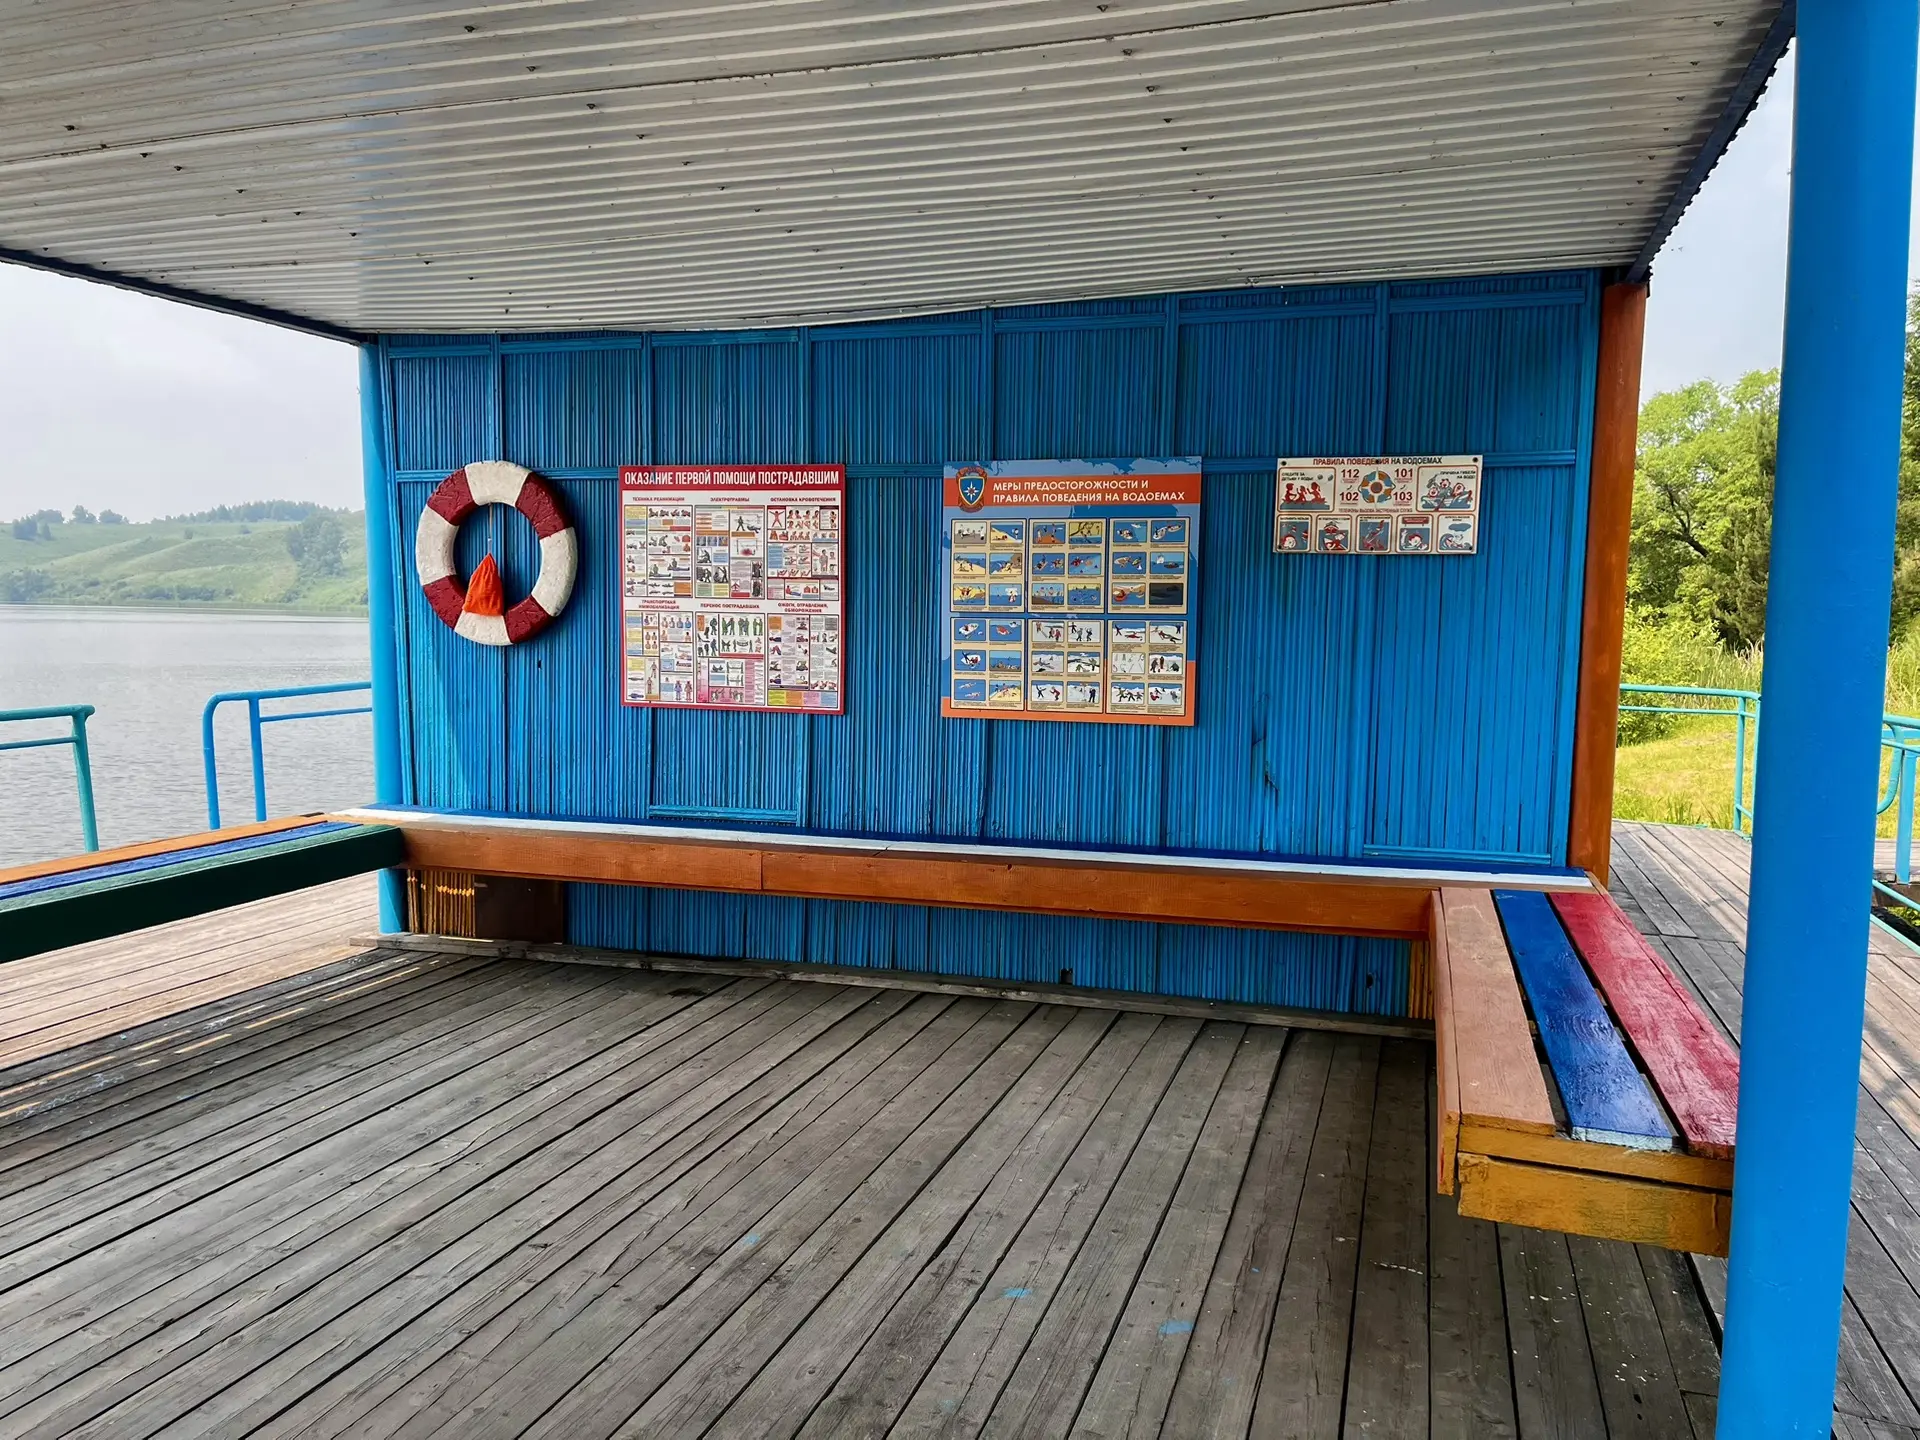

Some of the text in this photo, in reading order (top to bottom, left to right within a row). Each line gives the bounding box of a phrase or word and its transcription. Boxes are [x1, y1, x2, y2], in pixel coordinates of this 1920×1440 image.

[1402, 457, 1442, 465] ВОДОЕМАХ
[624, 469, 839, 486] ОКАЗАНИЕ ПЕРВОЙ ПОМОЩИ ПОСТРАДАВШИМ
[1341, 469, 1360, 478] 112
[1394, 468, 1413, 478] 101
[993, 480, 1149, 491] МЕРЫ ПРЕДОСТОРОЖНОСТИ И
[993, 491, 1185, 503] ПРАВИЛА ПОВЕДЕНИЯ НА ВОДОЕМАХ
[1340, 492, 1359, 501] 102
[1393, 491, 1413, 501] 103
